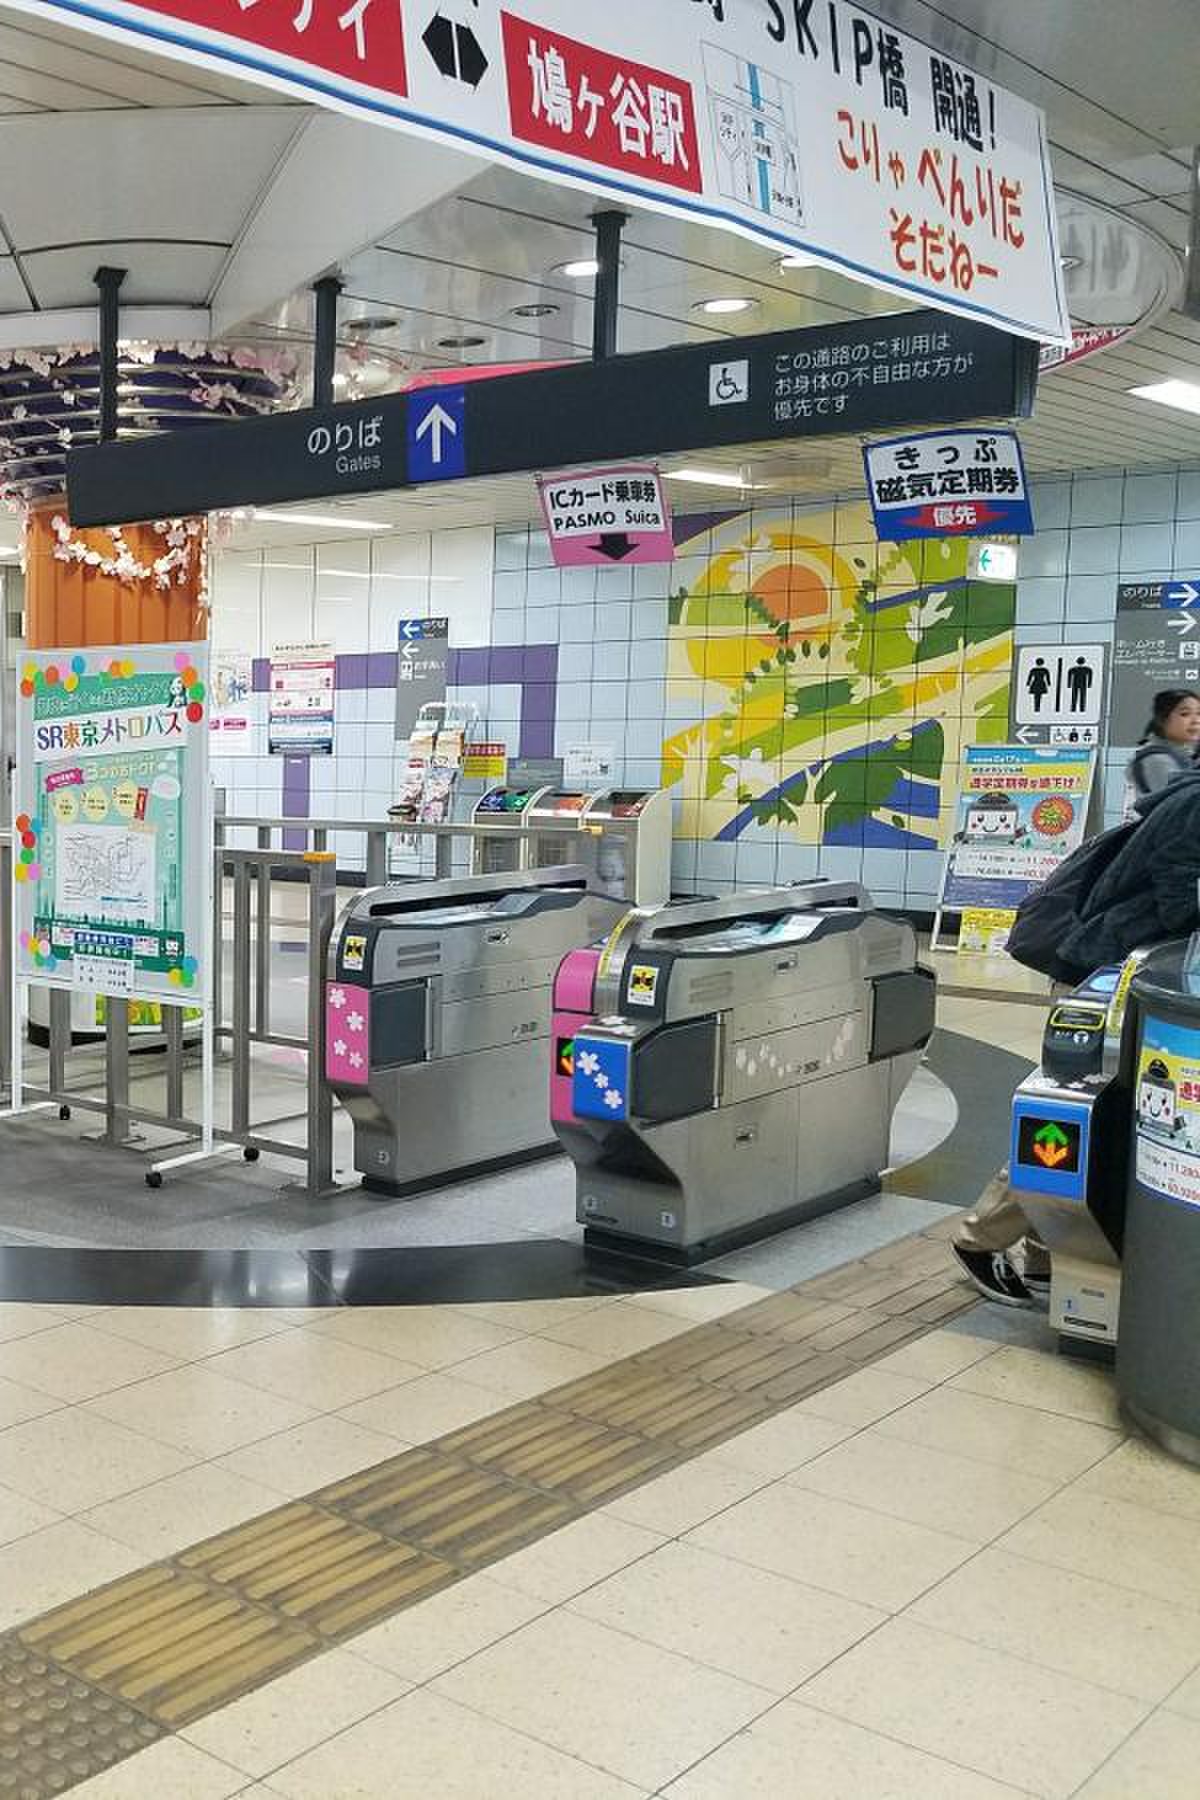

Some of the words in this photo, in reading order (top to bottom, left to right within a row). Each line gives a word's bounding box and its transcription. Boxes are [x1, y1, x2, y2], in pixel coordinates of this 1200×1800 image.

[890, 208, 999, 291] そだねー
[774, 332, 951, 374] この通路のご利用は
[773, 352, 974, 397] お身体の不自由な方が
[773, 395, 849, 420] 優先です
[307, 415, 384, 455] のりば
[335, 454, 382, 474] Gates
[549, 479, 657, 510] ICカード乗車券
[875, 467, 1020, 503] 磁気定期券
[554, 511, 616, 531] PASMO
[625, 509, 661, 525] Suica
[932, 504, 977, 528] 優先
